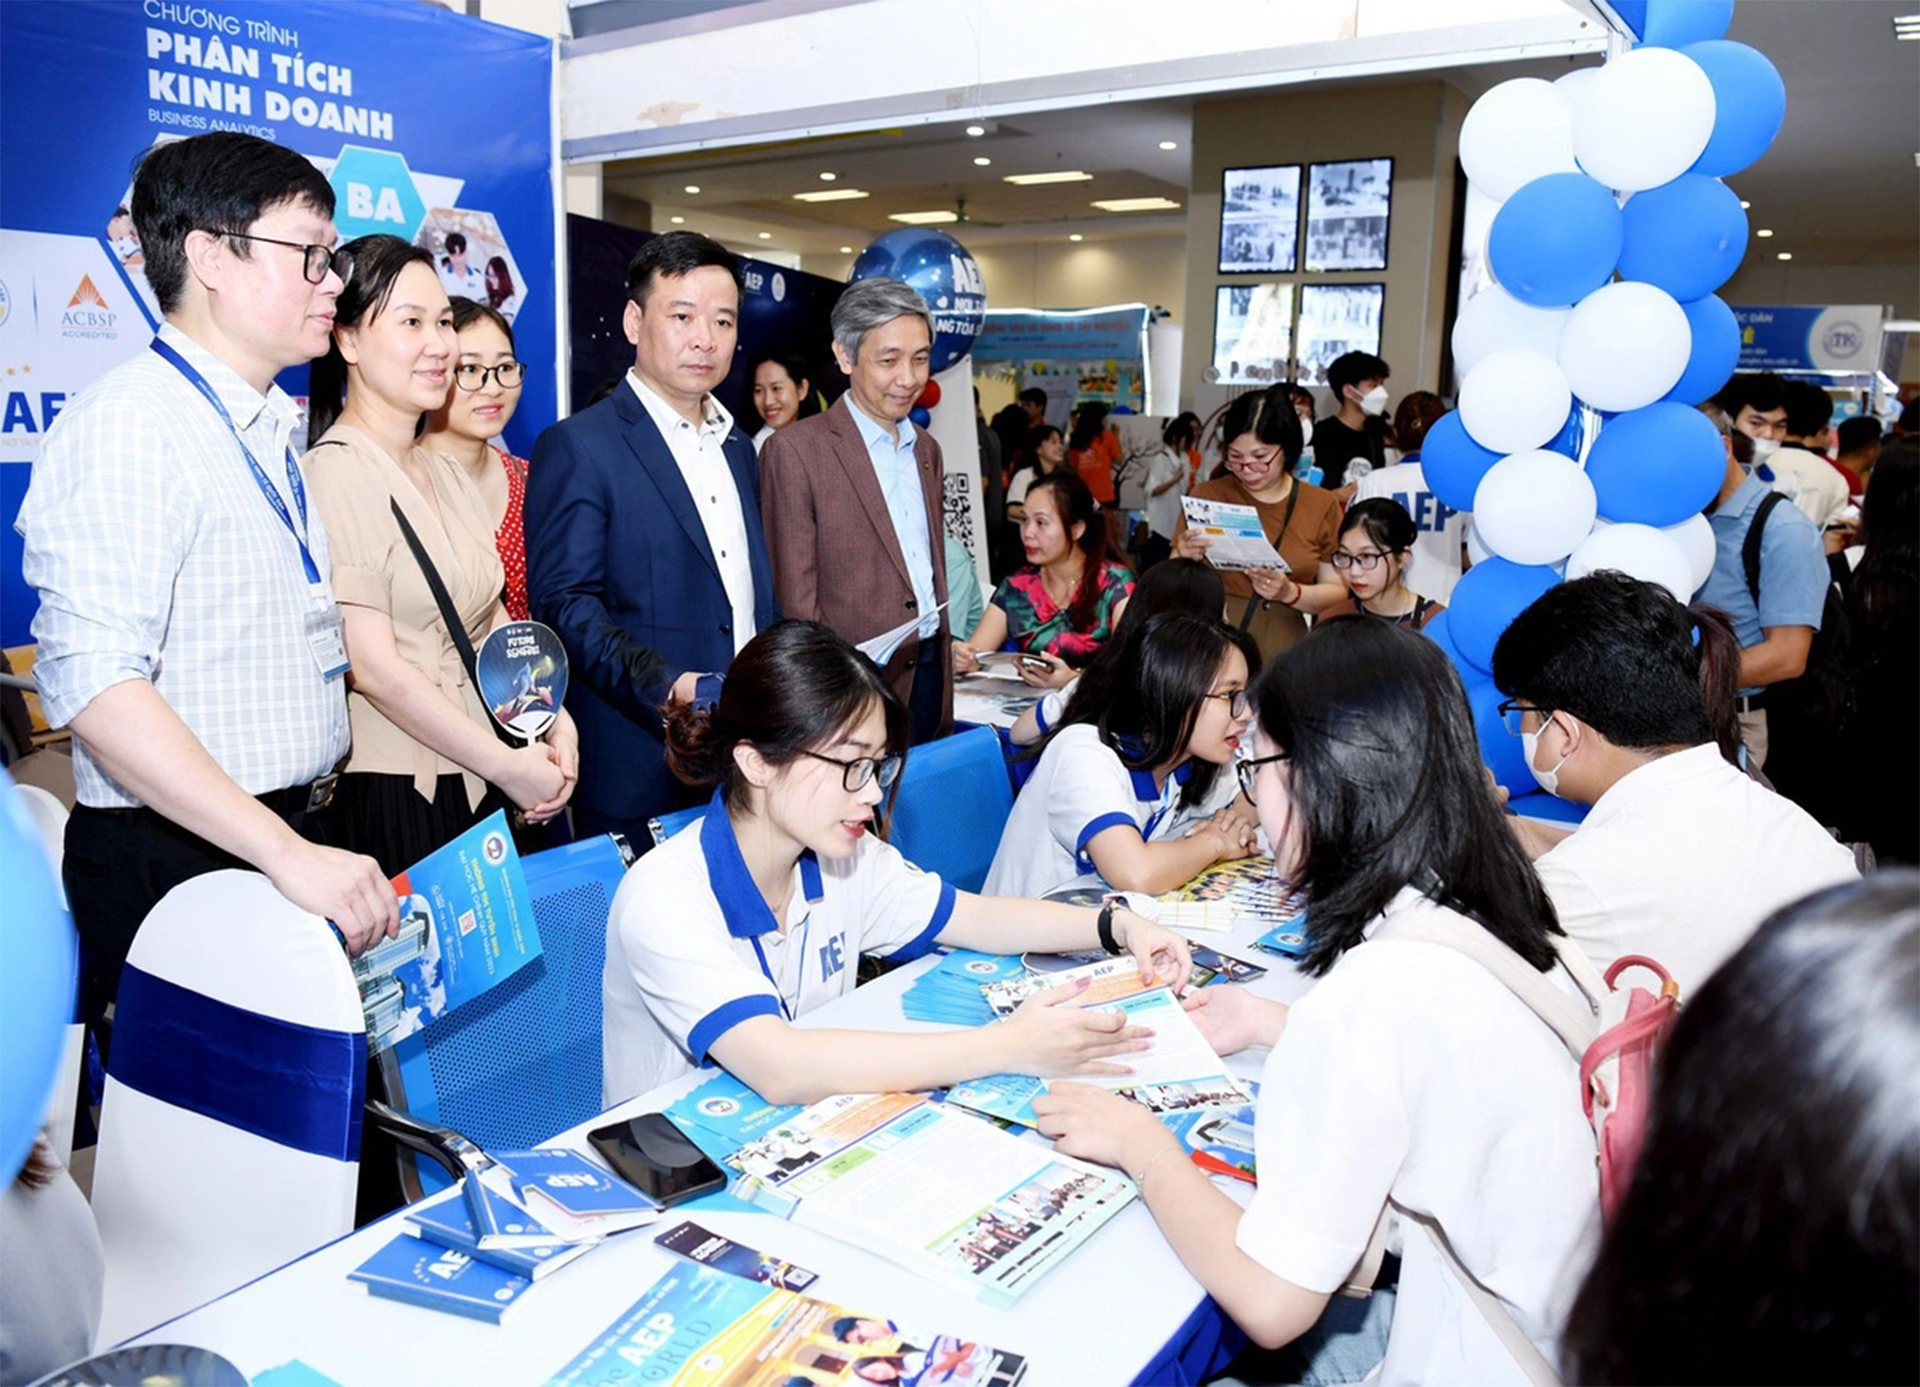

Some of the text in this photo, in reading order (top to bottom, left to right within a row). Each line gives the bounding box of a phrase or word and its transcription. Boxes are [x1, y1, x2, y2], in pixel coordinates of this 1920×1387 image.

[143, 0, 299, 48] CHƯƠNG TRÌNH
[146, 27, 352, 97] PHÂN TÍCH
[148, 69, 393, 141] KINH DOANH
[148, 108, 207, 130] BUSINESS
[347, 182, 406, 224] BA
[61, 311, 117, 326] ACBSP
[61, 330, 118, 340] ACCREDITED
[1093, 965, 1114, 977] AEP
[618, 1312, 676, 1367] AEP
